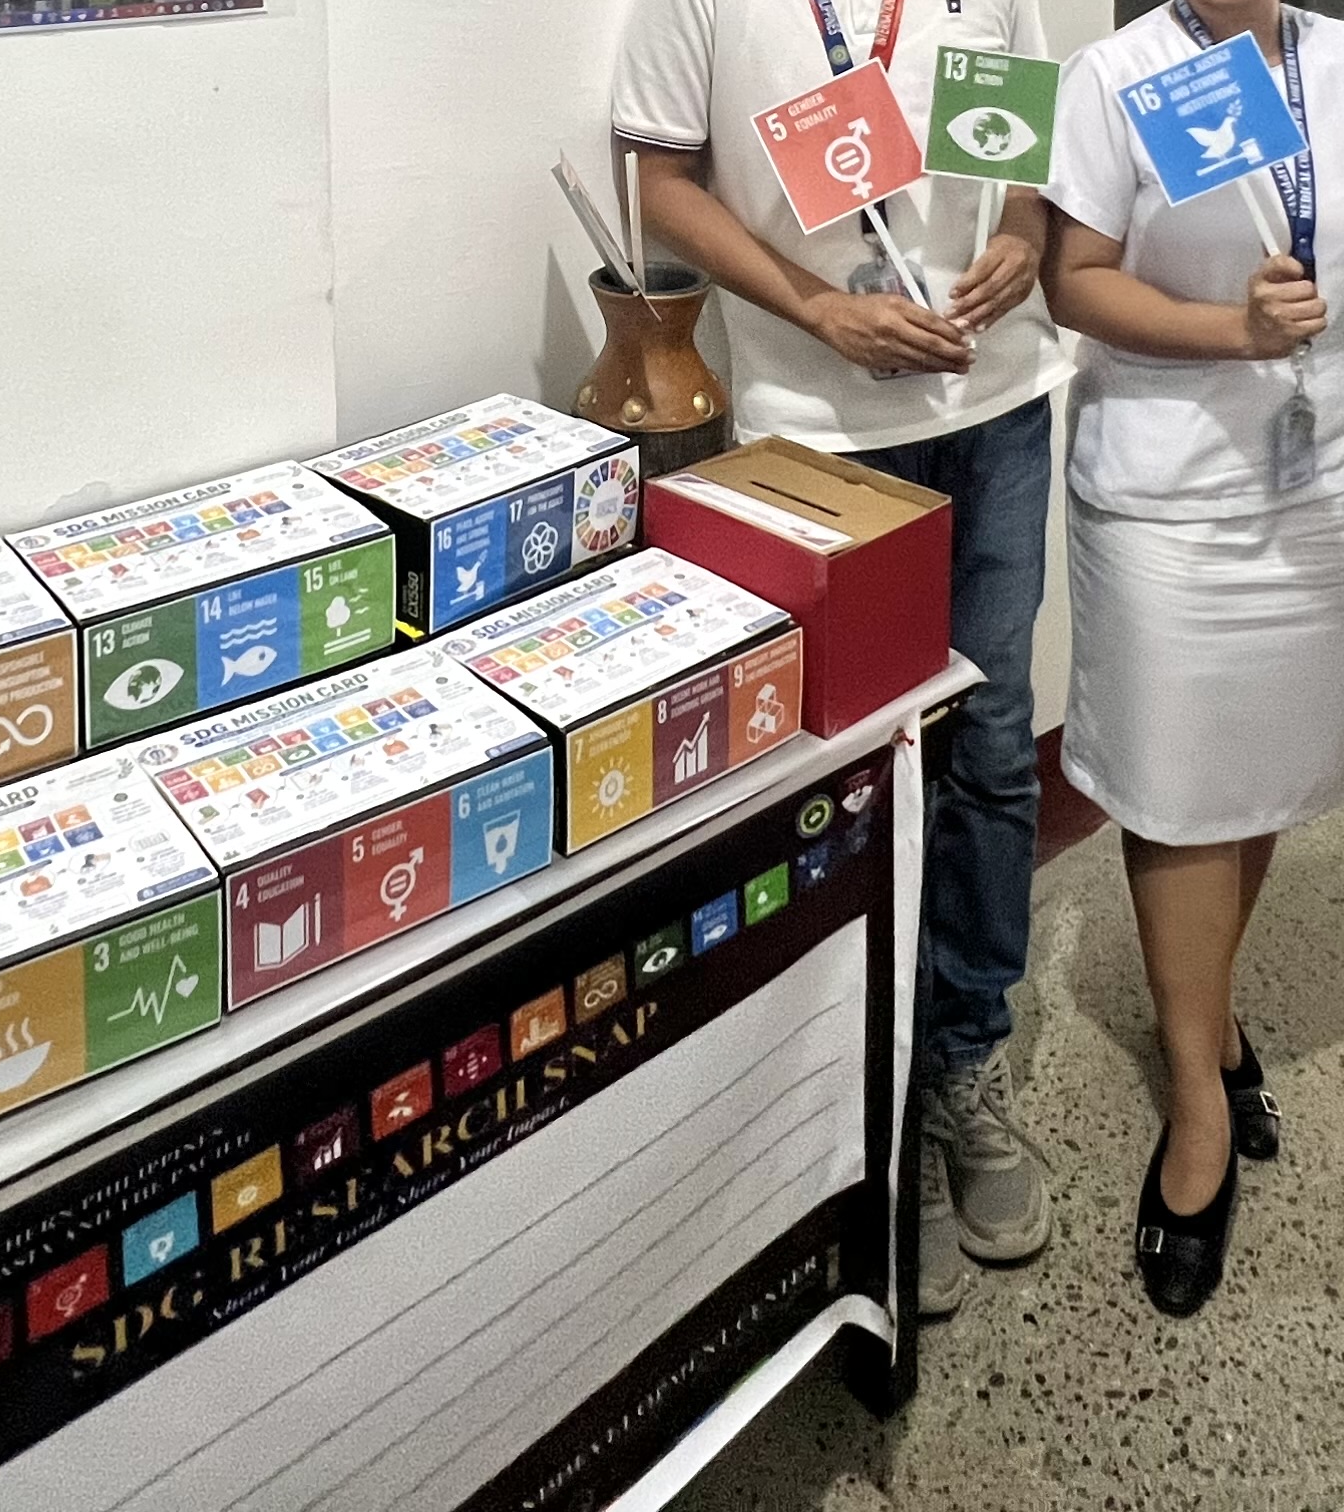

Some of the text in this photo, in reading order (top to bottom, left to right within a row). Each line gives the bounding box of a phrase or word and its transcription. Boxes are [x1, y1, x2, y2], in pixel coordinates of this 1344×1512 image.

[943, 51, 968, 82] 13
[787, 92, 826, 118] GENDER
[1126, 82, 1161, 116] 16
[765, 112, 788, 143] 5
[793, 103, 839, 133] EQUALITY
[1296, 169, 1314, 219] MEDICAL
[53, 481, 233, 538] SDG MISSION CARD
[509, 497, 523, 525] 17
[437, 526, 452, 554] 16
[304, 563, 323, 595] 15
[406, 570, 420, 618] CX550
[200, 594, 222, 626] 14
[471, 574, 615, 642] SDG MISSION CARD
[92, 627, 116, 660] 13
[733, 663, 743, 689] 9
[179, 671, 369, 748] SDG MISSION CARD
[657, 697, 667, 725] 8
[457, 790, 470, 821] 6
[371, 818, 402, 842] GENDER
[371, 830, 408, 856] EQUALITY
[352, 834, 364, 864] 5
[257, 862, 292, 888] QUALITY
[257, 873, 304, 904] EDUCATION
[235, 879, 249, 912] 4
[118, 911, 185, 949] GOOD HEALTH
[118, 921, 199, 964] AND WELL-BEING
[93, 938, 111, 975] 3
[70, 1001, 658, 1378] SDG RESEARCH SNAP
